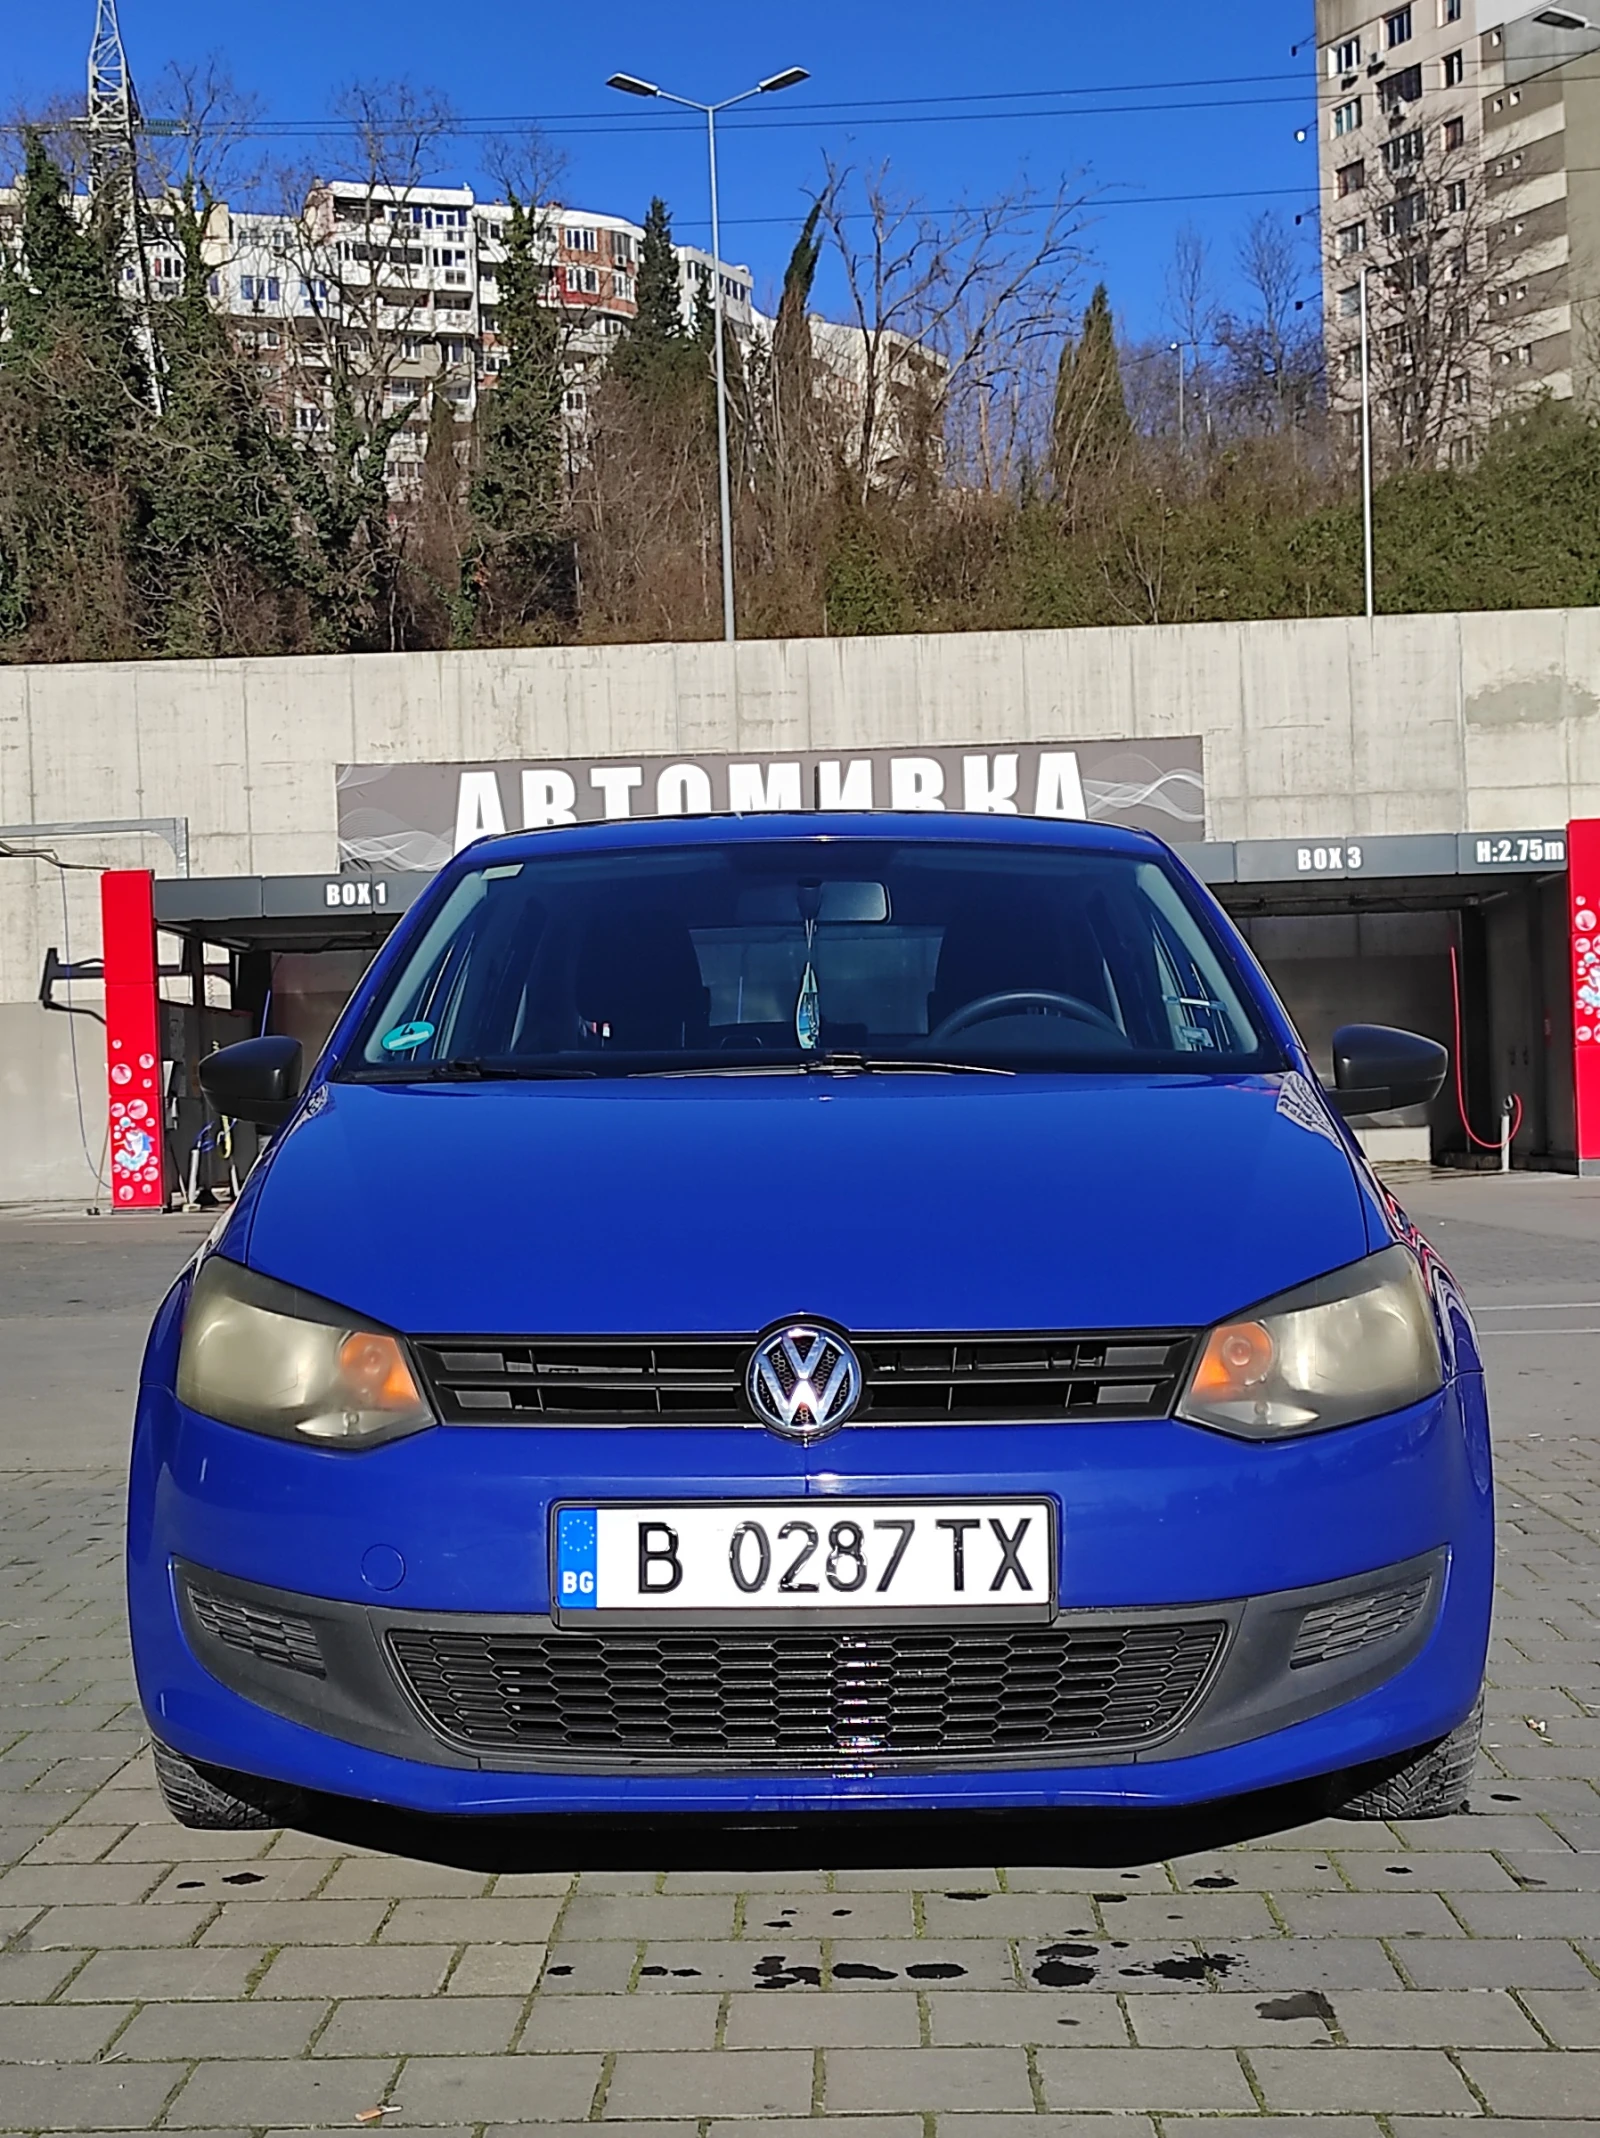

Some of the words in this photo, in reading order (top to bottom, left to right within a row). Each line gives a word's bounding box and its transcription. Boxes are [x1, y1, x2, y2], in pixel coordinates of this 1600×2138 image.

[1297, 847, 1343, 871] BOX
[1347, 846, 1362, 868] 3
[1476, 839, 1565, 863] H:2.75m
[326, 882, 371, 906] BOX
[375, 882, 386, 904] 1
[638, 1521, 684, 1595] B
[728, 1519, 916, 1594] 0287
[935, 1517, 1034, 1593] TX
[562, 1570, 595, 1594] BG
